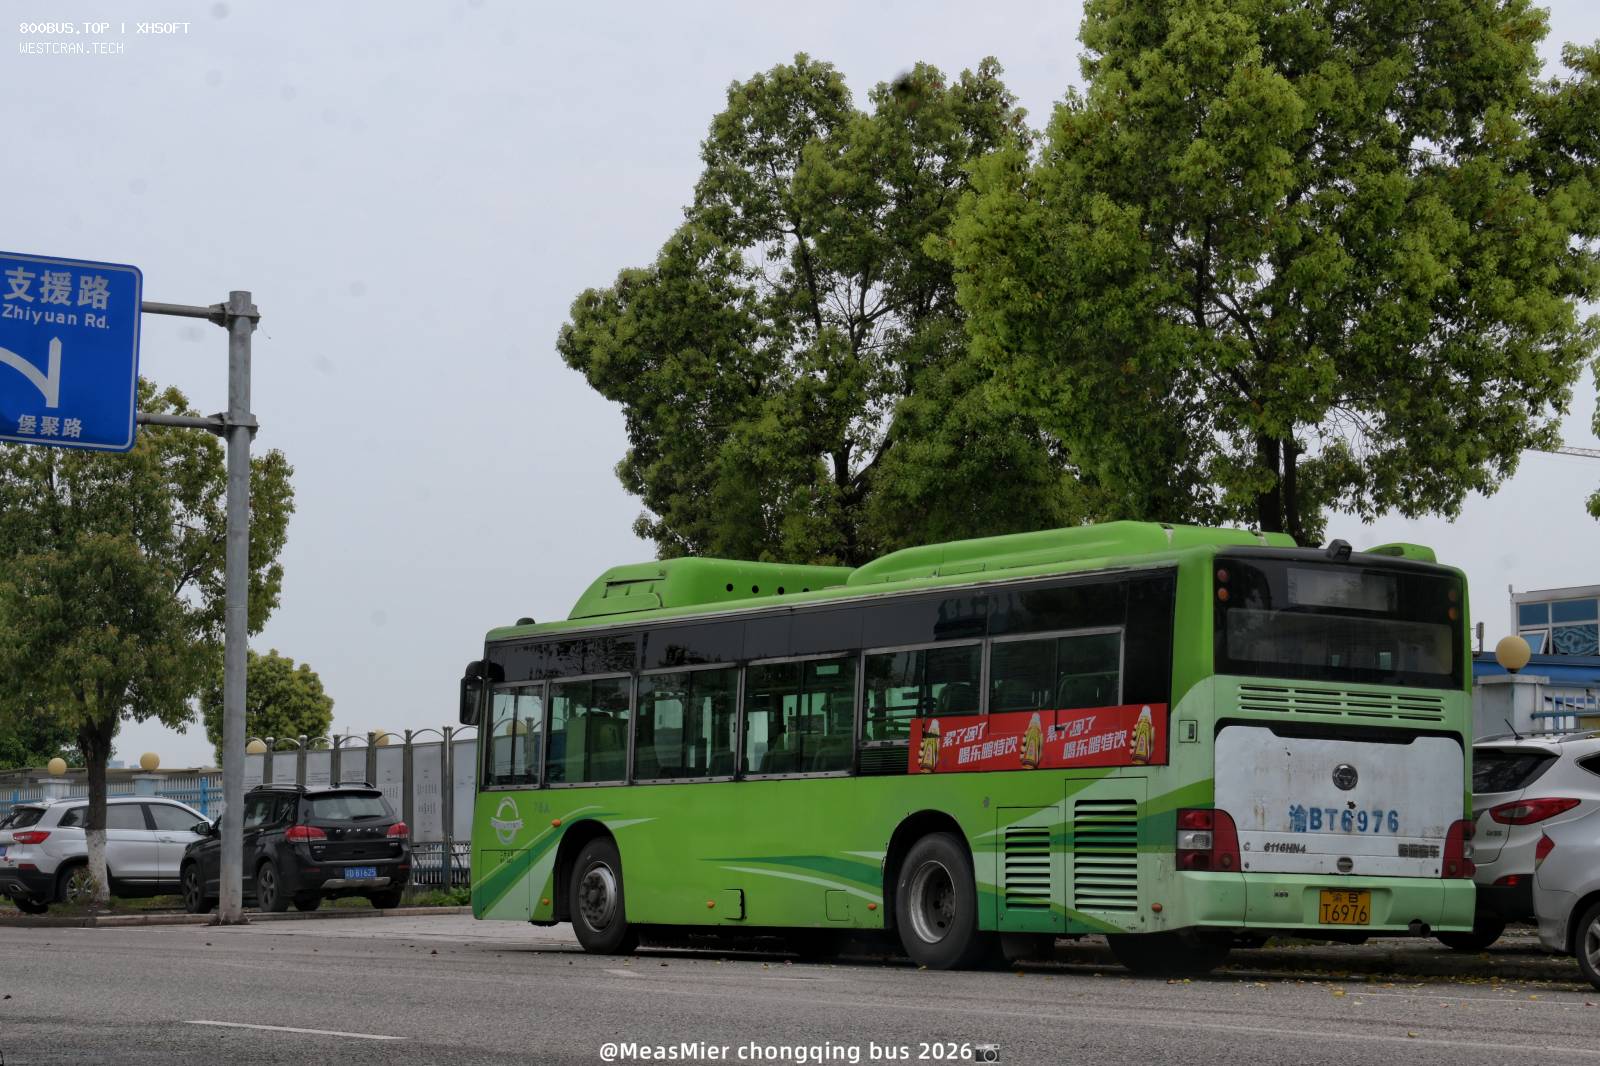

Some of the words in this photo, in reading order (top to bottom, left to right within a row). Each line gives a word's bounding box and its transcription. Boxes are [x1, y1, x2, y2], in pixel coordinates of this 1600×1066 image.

[3, 266, 110, 310] 支援路
[2, 303, 77, 326] Zhiyuan
[84, 313, 110, 329] Rd.
[17, 414, 82, 438] 堡聚路
[942, 722, 987, 748] 累了困了
[1046, 716, 1096, 743] 累了困了
[958, 736, 1018, 765] 喝东鹏特饮
[1063, 729, 1127, 760] 喝东鹏特饮
[1288, 804, 1399, 833] 渝BT6976
[1322, 904, 1368, 922] T6976
